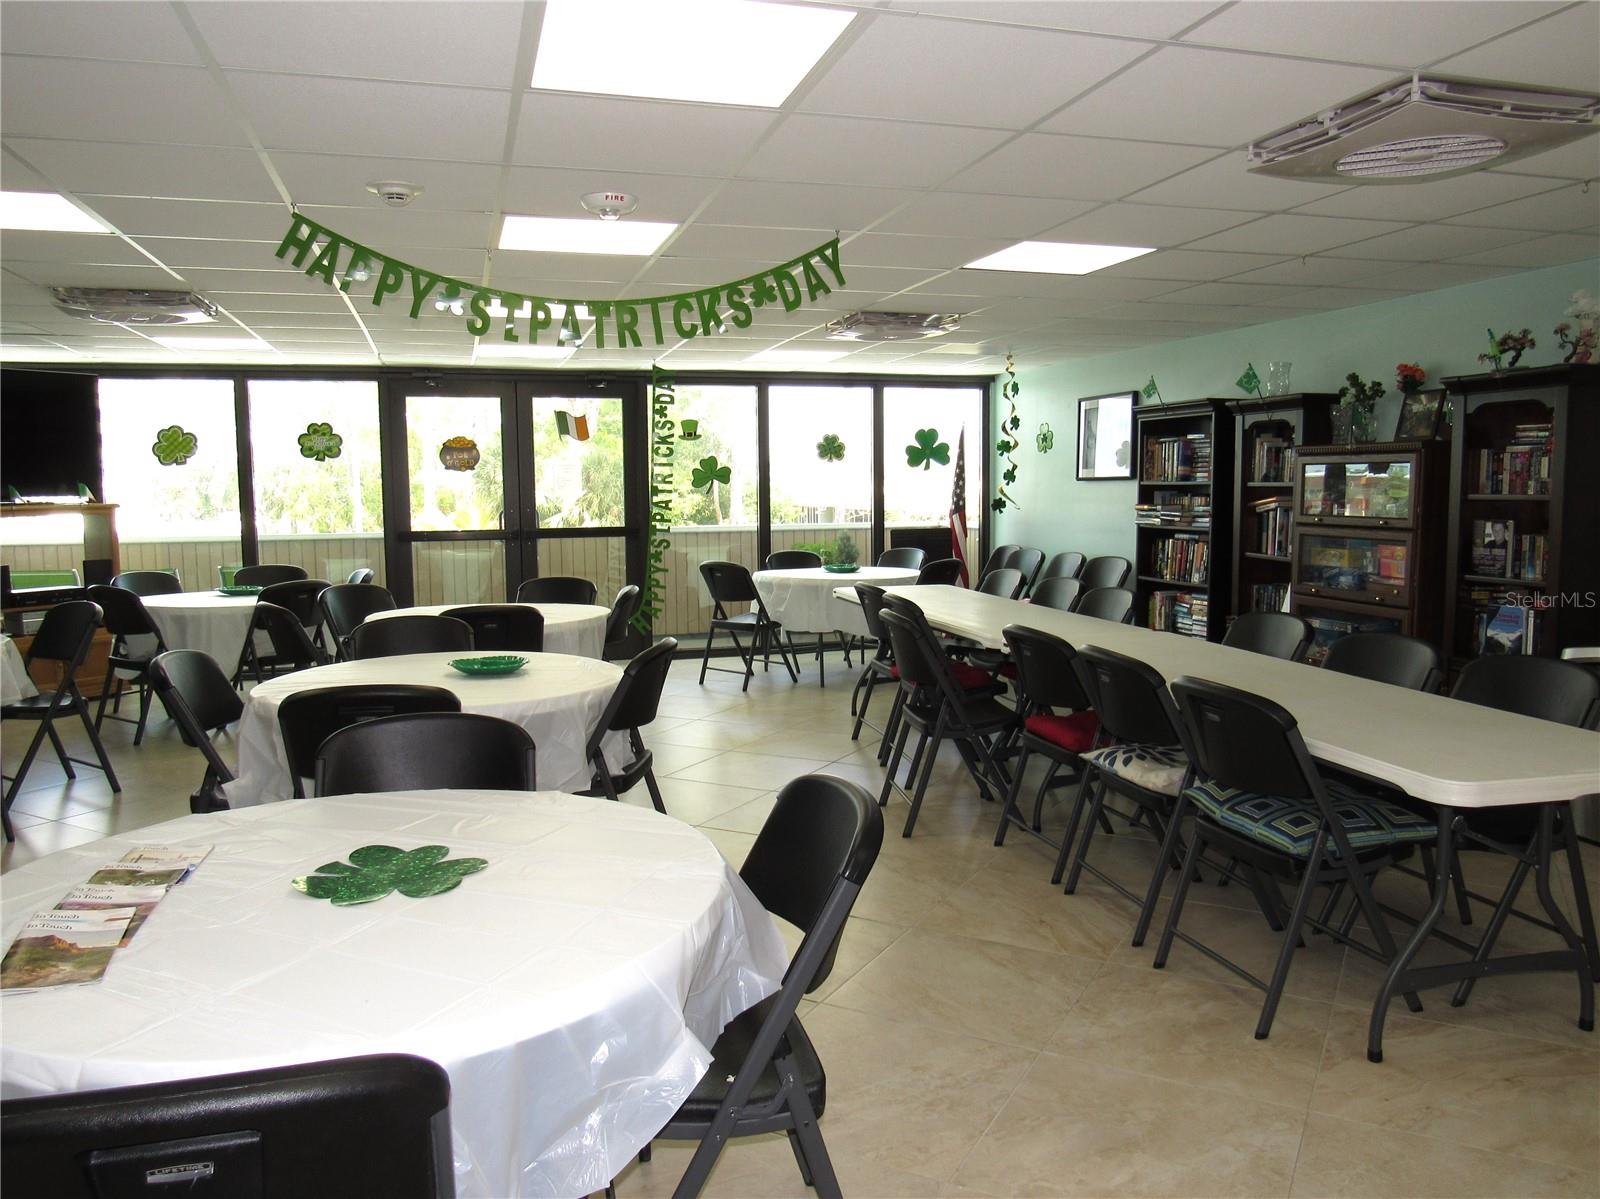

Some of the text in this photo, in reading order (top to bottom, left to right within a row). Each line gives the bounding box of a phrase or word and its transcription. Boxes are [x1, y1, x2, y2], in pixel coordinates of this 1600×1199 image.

[275, 216, 440, 319] HAPPY
[772, 241, 846, 313] DAY
[629, 564, 669, 637] HAPPY
